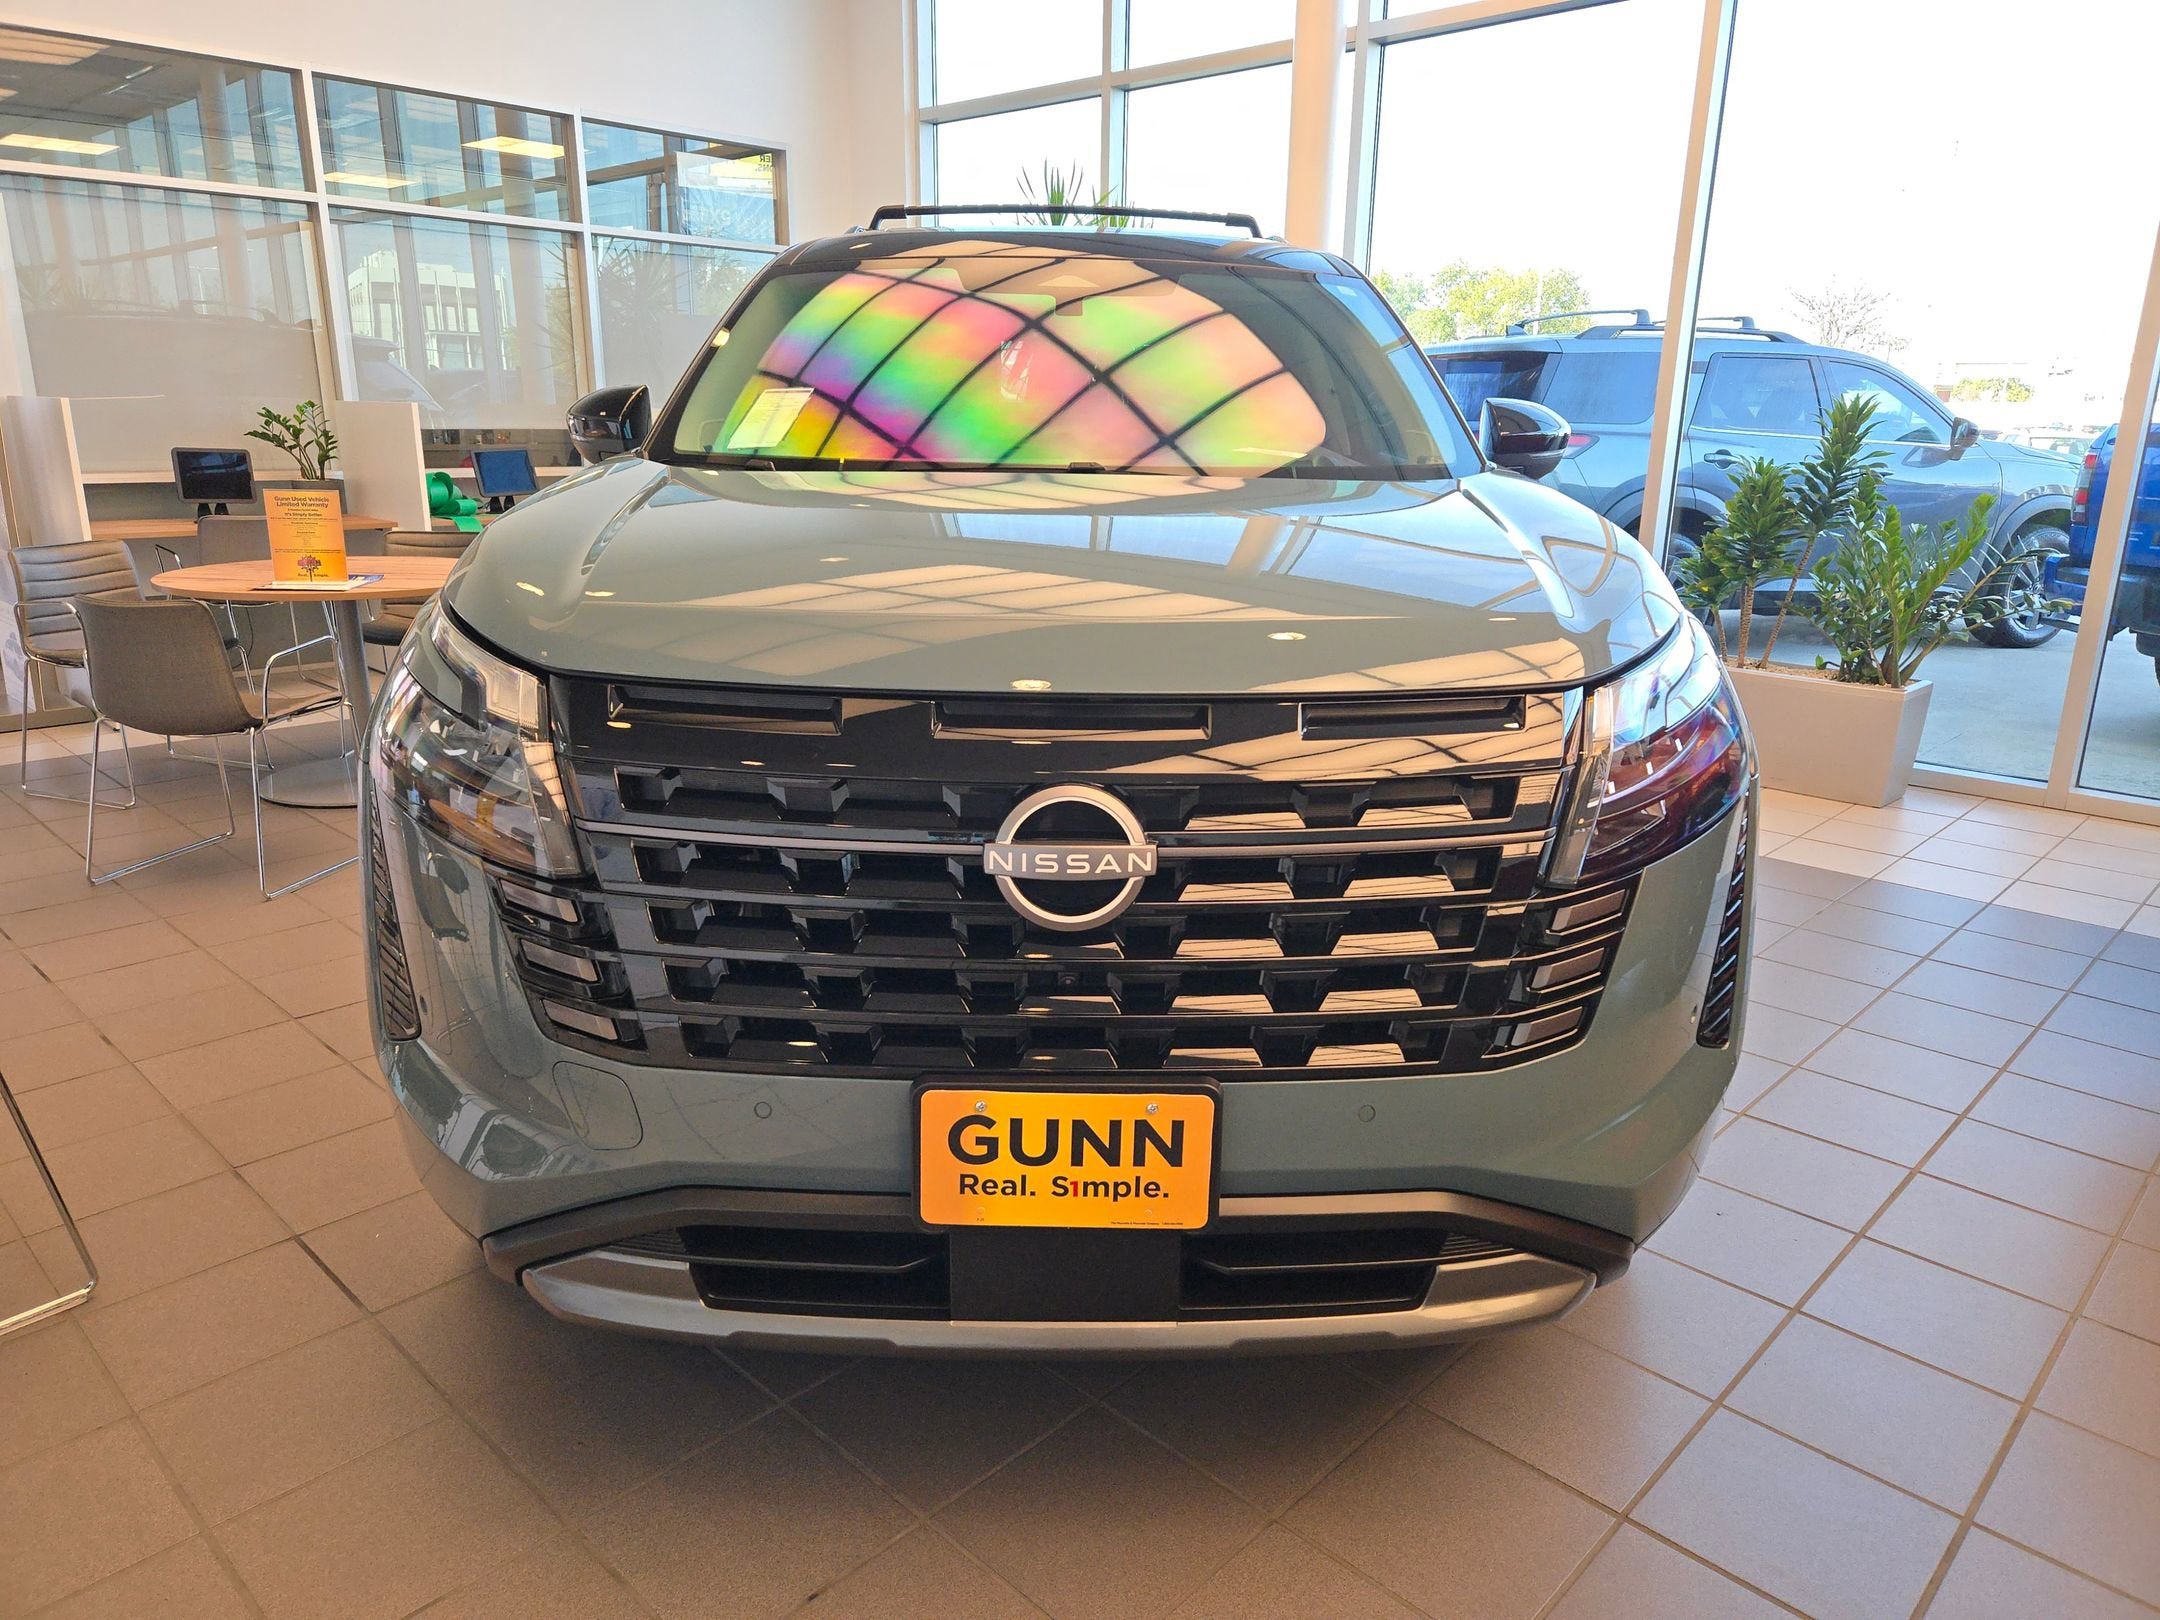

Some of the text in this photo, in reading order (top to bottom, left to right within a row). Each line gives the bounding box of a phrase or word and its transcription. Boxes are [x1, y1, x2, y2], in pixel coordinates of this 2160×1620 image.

[988, 850, 1153, 874] NISSAN
[947, 1114, 1185, 1168] GUNN
[959, 1173, 1169, 1202] Real. S1mple.
